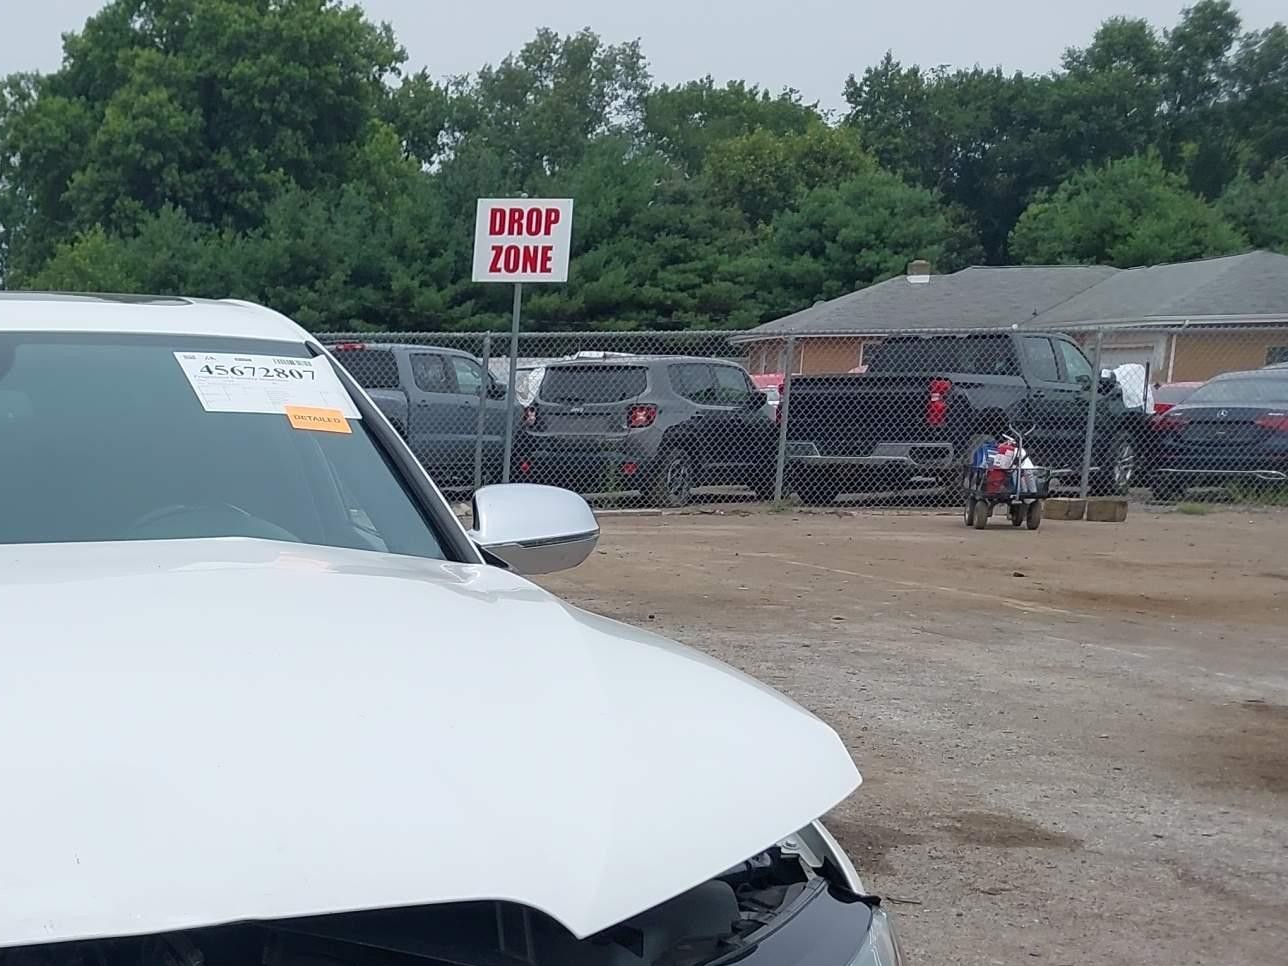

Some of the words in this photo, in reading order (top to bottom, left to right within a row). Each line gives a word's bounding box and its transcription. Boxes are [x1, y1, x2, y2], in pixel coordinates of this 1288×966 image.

[489, 207, 561, 236] DROP
[489, 245, 554, 274] ZONE
[200, 363, 316, 381] 45672807
[293, 414, 341, 425] DETAILED
